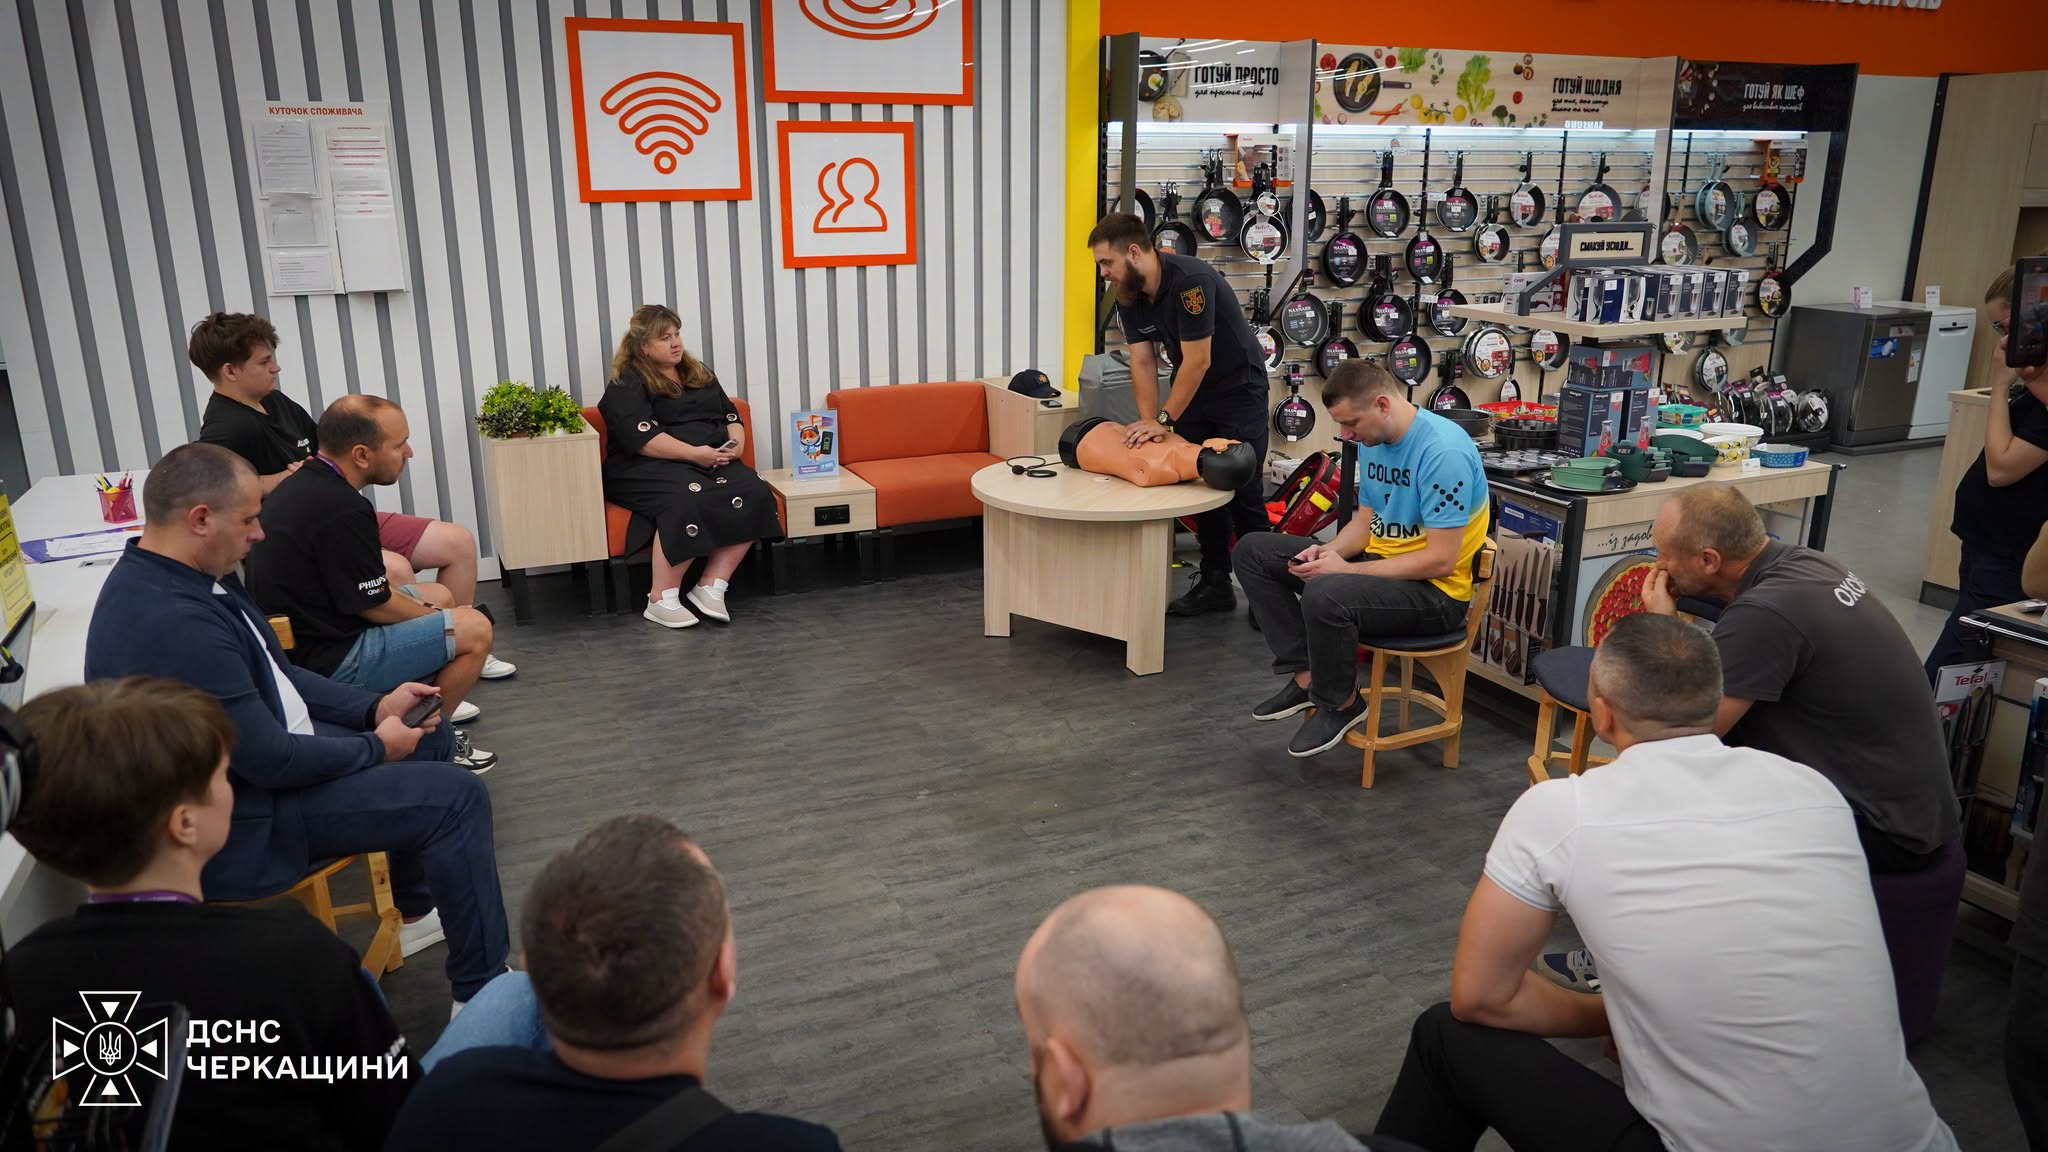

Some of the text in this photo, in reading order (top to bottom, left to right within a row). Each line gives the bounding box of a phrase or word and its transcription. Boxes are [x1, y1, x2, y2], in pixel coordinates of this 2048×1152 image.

[1194, 64, 1279, 85] ГОТУЙ ПРОСТО
[1552, 76, 1622, 96] ГОТУЙ ЩОДНЯ
[1743, 81, 1805, 100] ГОТУЙ ЯК ШЕФ
[268, 107, 363, 116] КУТОЧОК СПОЖИВАЧА
[1367, 461, 1411, 488] COLRS
[358, 575, 387, 591] PHILIPS
[1954, 671, 1988, 687] Tefal
